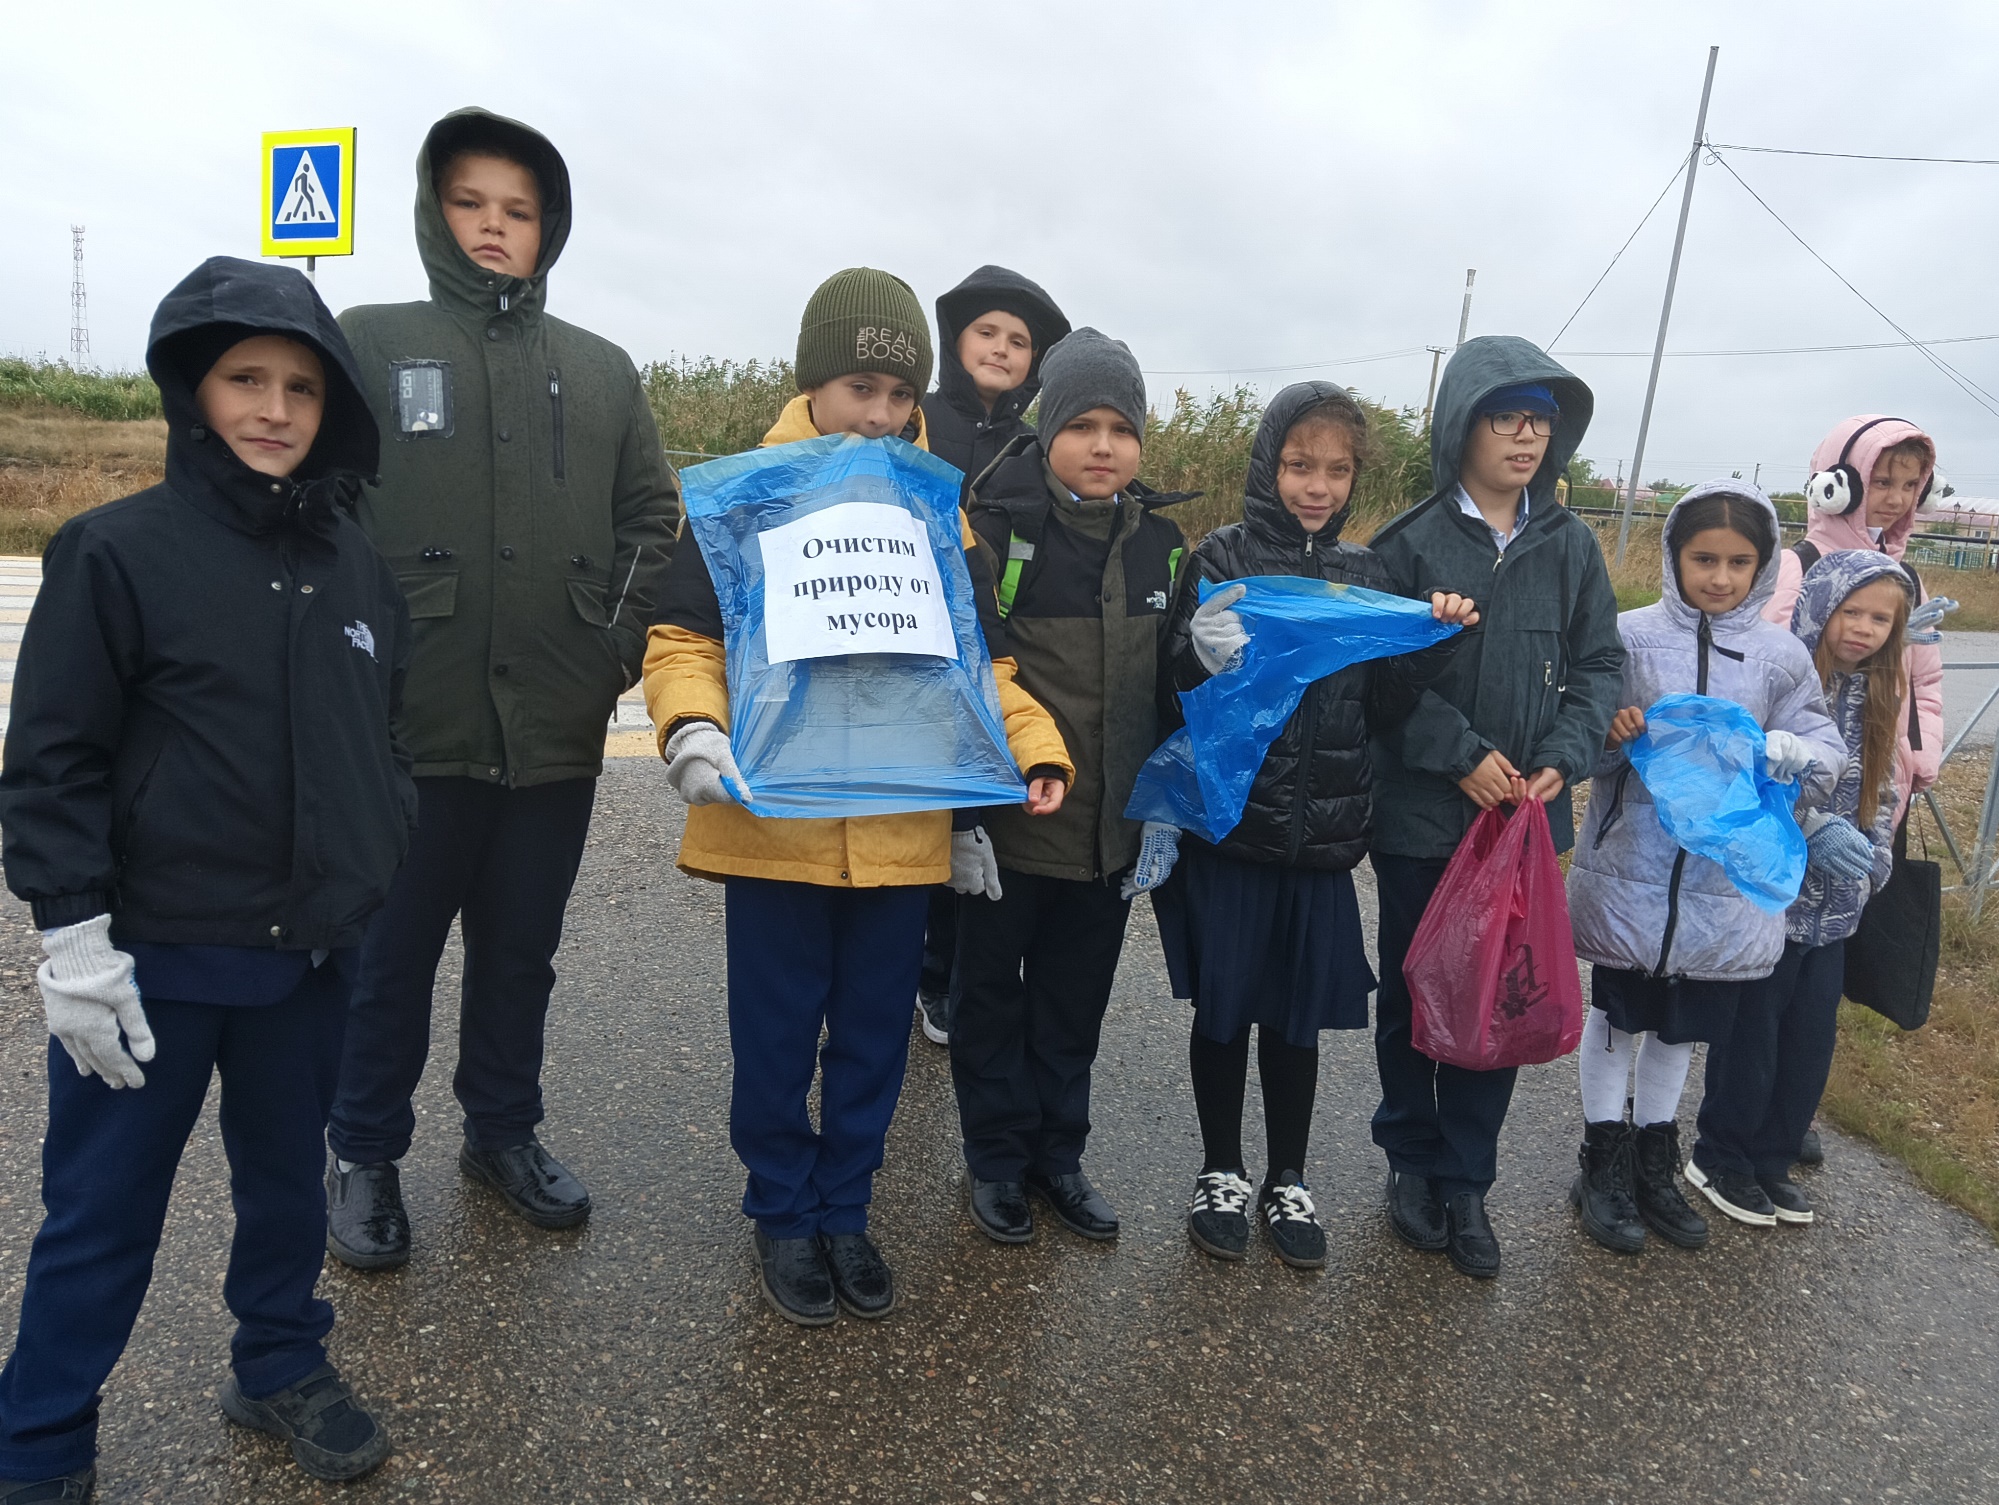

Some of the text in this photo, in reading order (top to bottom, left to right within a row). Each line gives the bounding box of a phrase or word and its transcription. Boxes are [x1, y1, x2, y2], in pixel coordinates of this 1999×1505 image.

[866, 327, 917, 351] REAL
[856, 341, 917, 366] BOSS
[802, 536, 917, 559] Очистим
[793, 573, 931, 600] природу от
[827, 611, 918, 636] мусора
